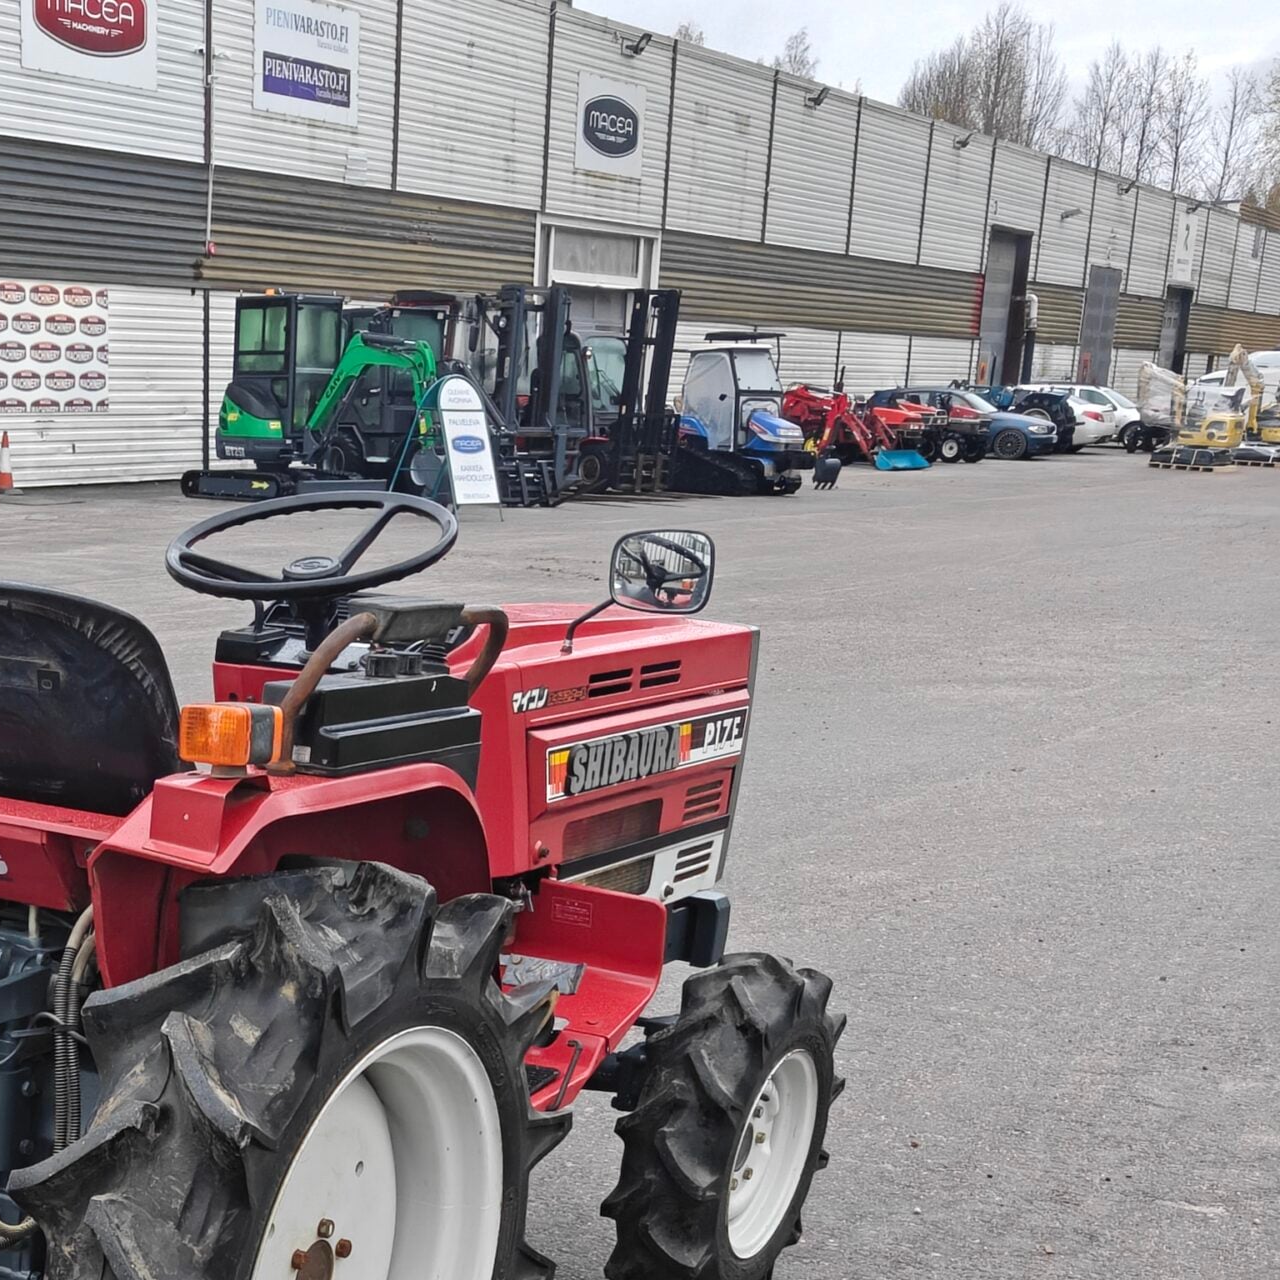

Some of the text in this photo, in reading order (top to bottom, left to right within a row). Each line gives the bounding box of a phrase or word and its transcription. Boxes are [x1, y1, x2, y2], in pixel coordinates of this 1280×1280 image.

[266, 7, 349, 44] PIENIVARASTO.FI
[265, 57, 348, 92] PIENIVARASTO.FI
[590, 110, 634, 136] MACEA
[568, 716, 741, 794] SHIBAURA P17F
